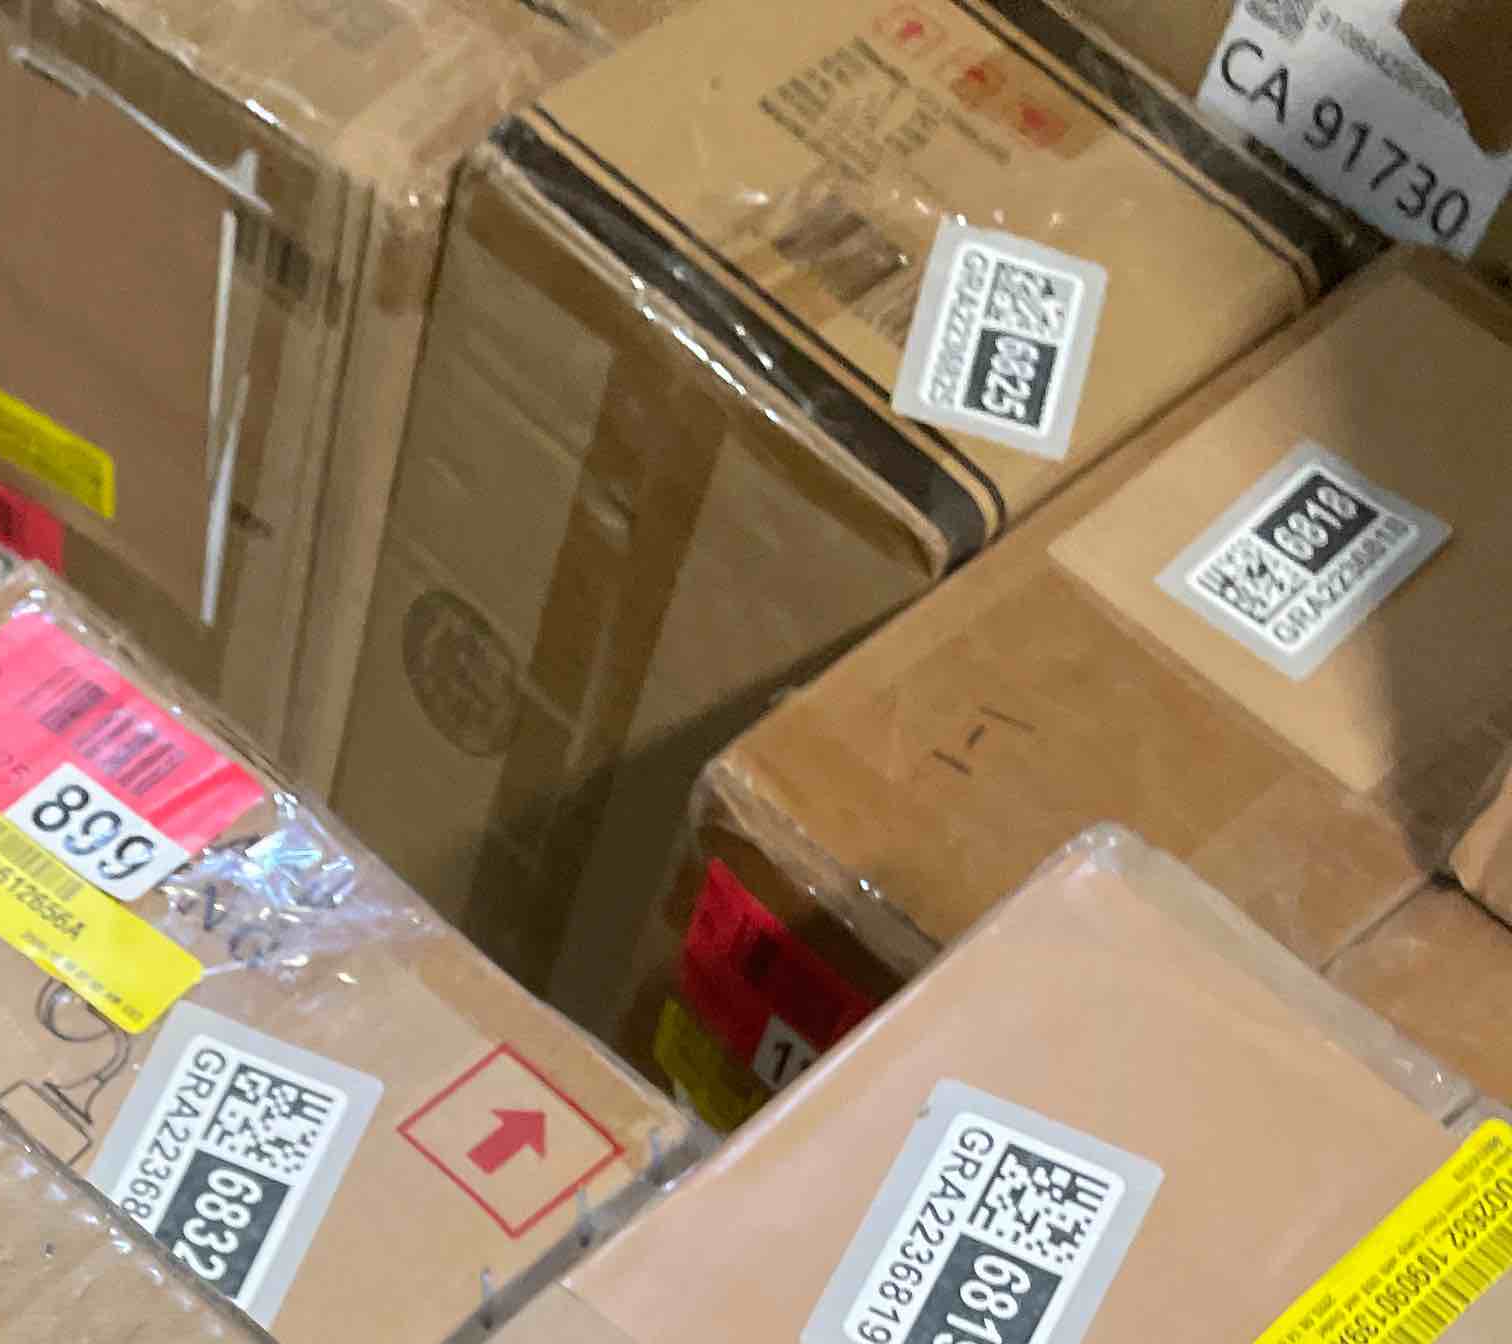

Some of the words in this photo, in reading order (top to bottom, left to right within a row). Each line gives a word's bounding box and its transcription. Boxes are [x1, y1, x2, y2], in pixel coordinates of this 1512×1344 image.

[1220, 38, 1291, 123] CA
[1303, 95, 1472, 241] 91730
[27, 779, 158, 888] 899
[166, 1161, 268, 1286] 6832
[859, 1126, 994, 1344] GRA2236819
